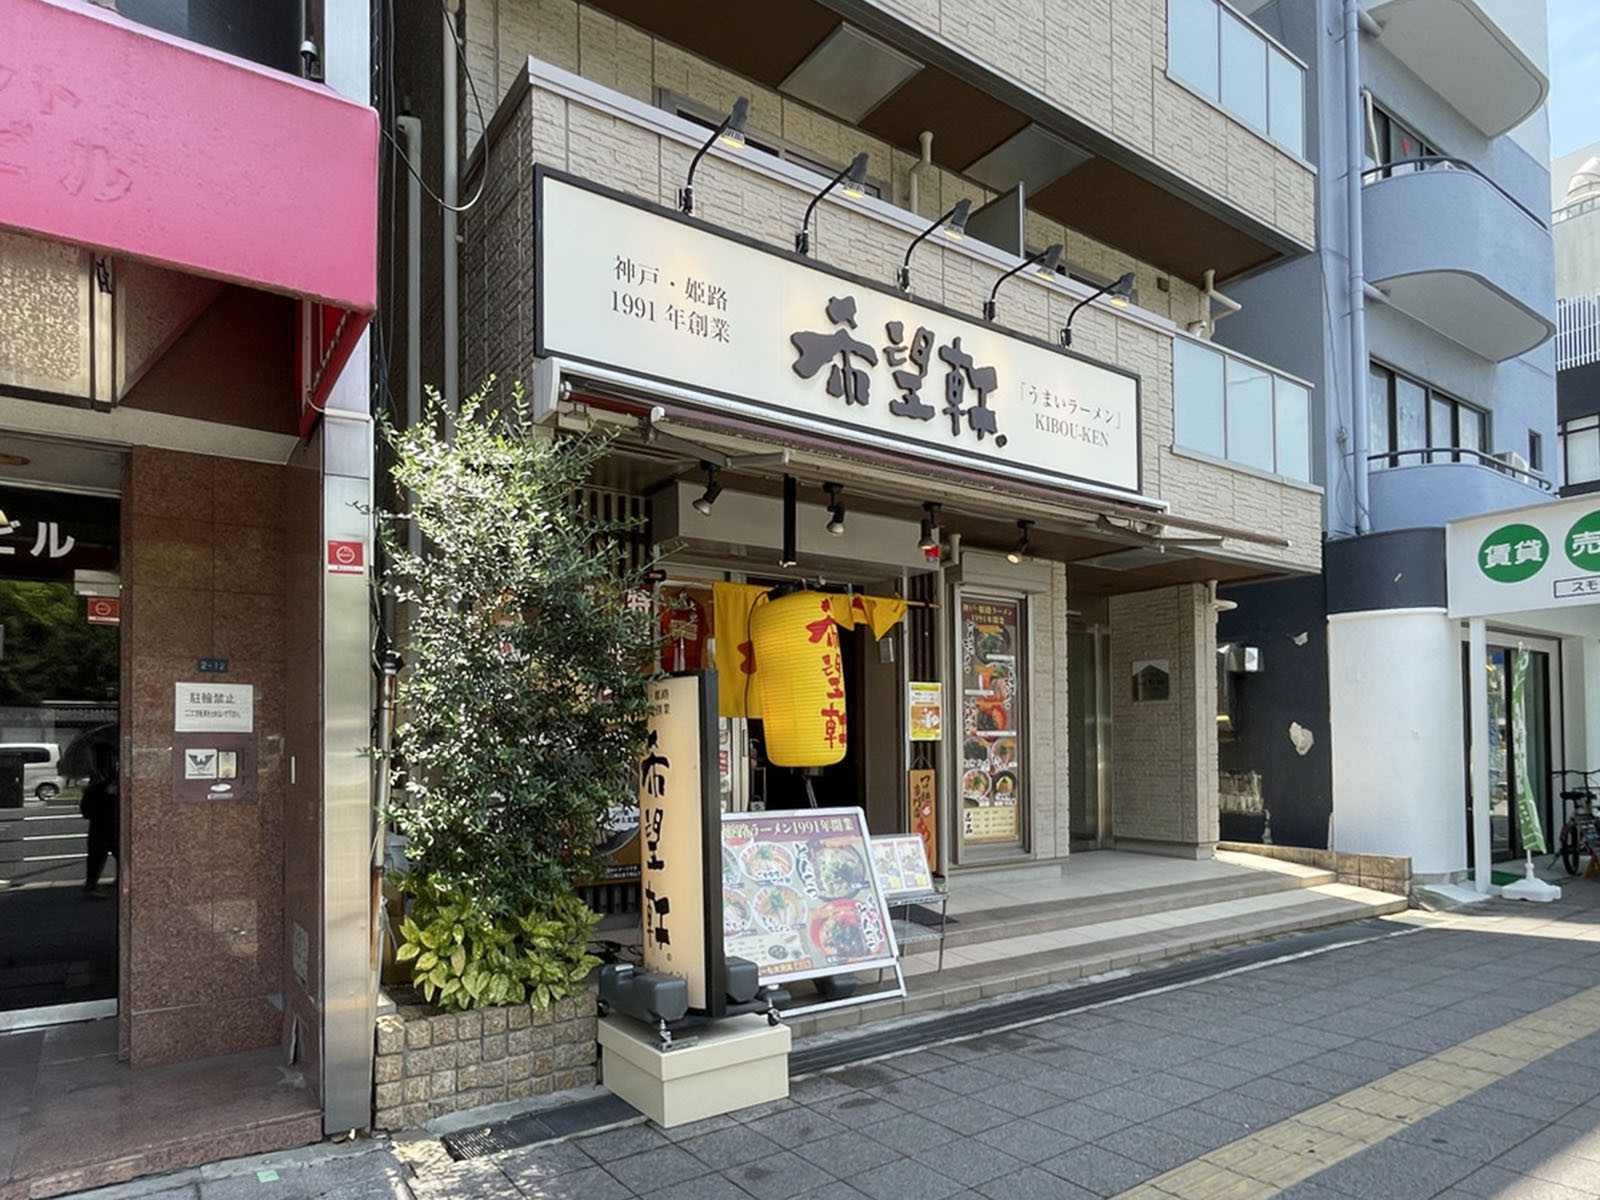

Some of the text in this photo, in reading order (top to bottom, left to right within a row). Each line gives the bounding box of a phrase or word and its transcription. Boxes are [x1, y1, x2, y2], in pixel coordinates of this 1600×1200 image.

[613, 254, 728, 311] 神戸・姫路
[789, 295, 999, 442] 希望軒
[1020, 382, 1121, 430] 「うまいラーメン」
[1035, 413, 1109, 446] KIBOU-KEN
[1484, 539, 1543, 568] 賃貸
[190, 692, 236, 705] 駐輪禁止
